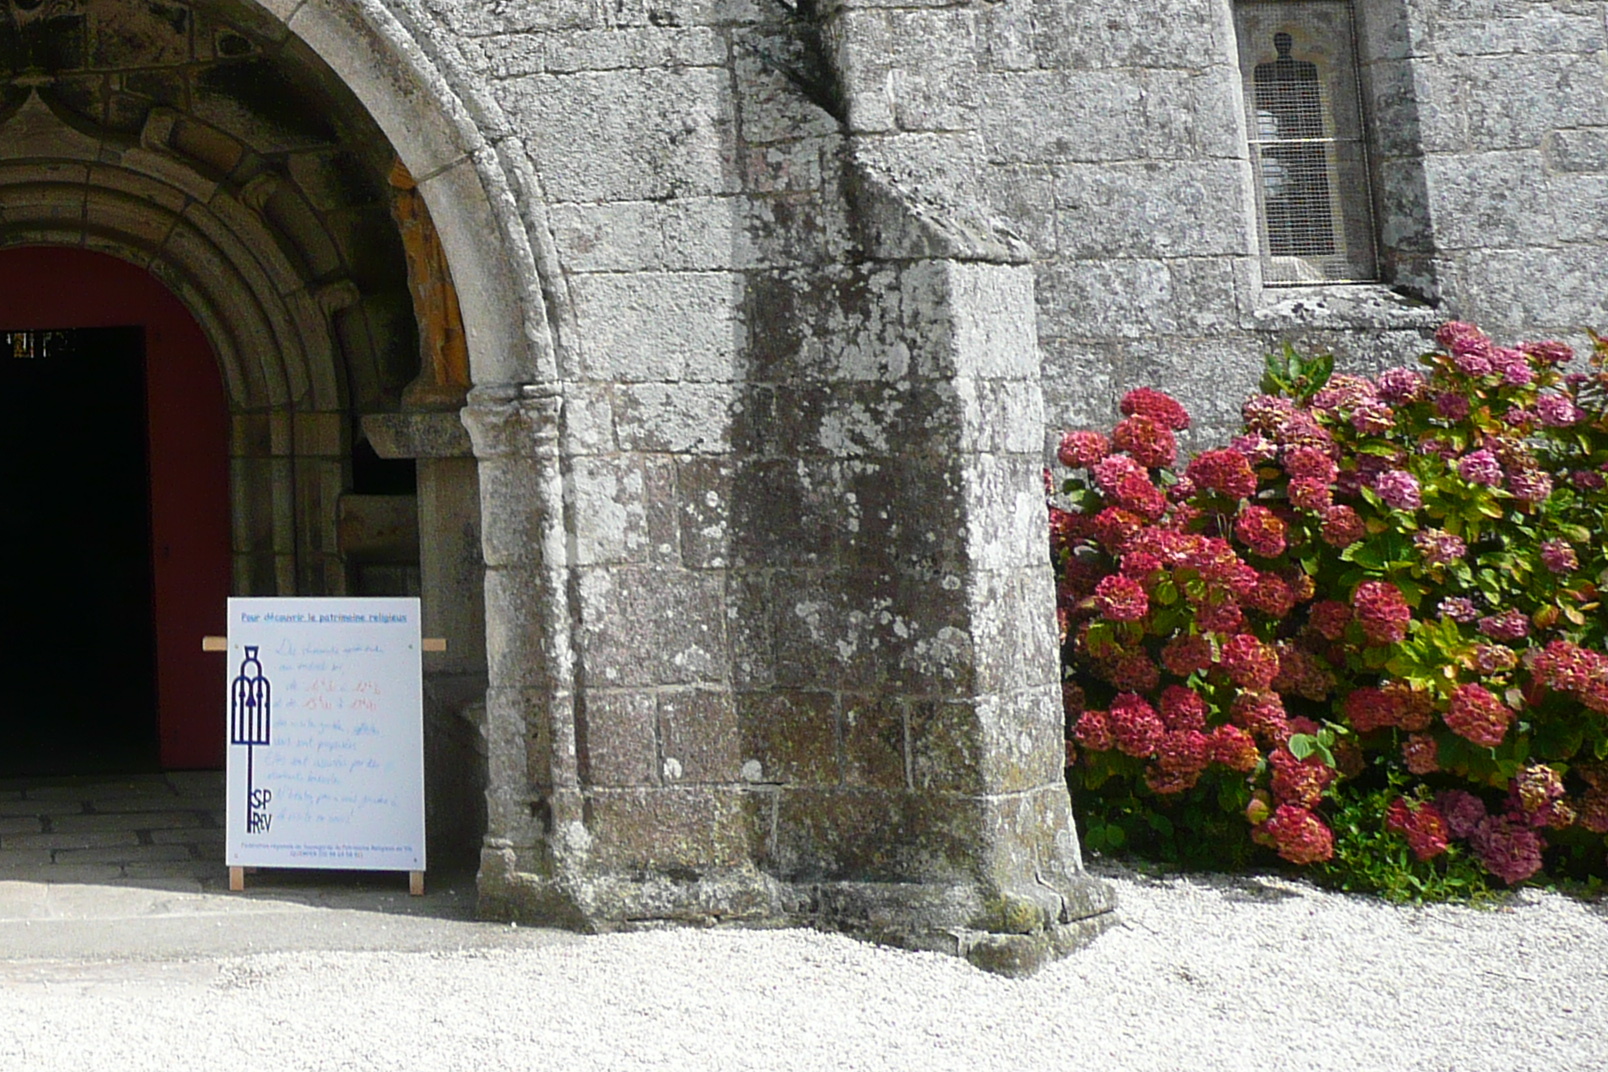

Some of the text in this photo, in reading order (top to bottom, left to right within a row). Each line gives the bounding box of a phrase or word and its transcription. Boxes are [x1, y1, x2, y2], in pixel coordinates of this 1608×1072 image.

[241, 612, 408, 624] Pour découvrir le patrimoine religieux
[251, 789, 272, 810] SP
